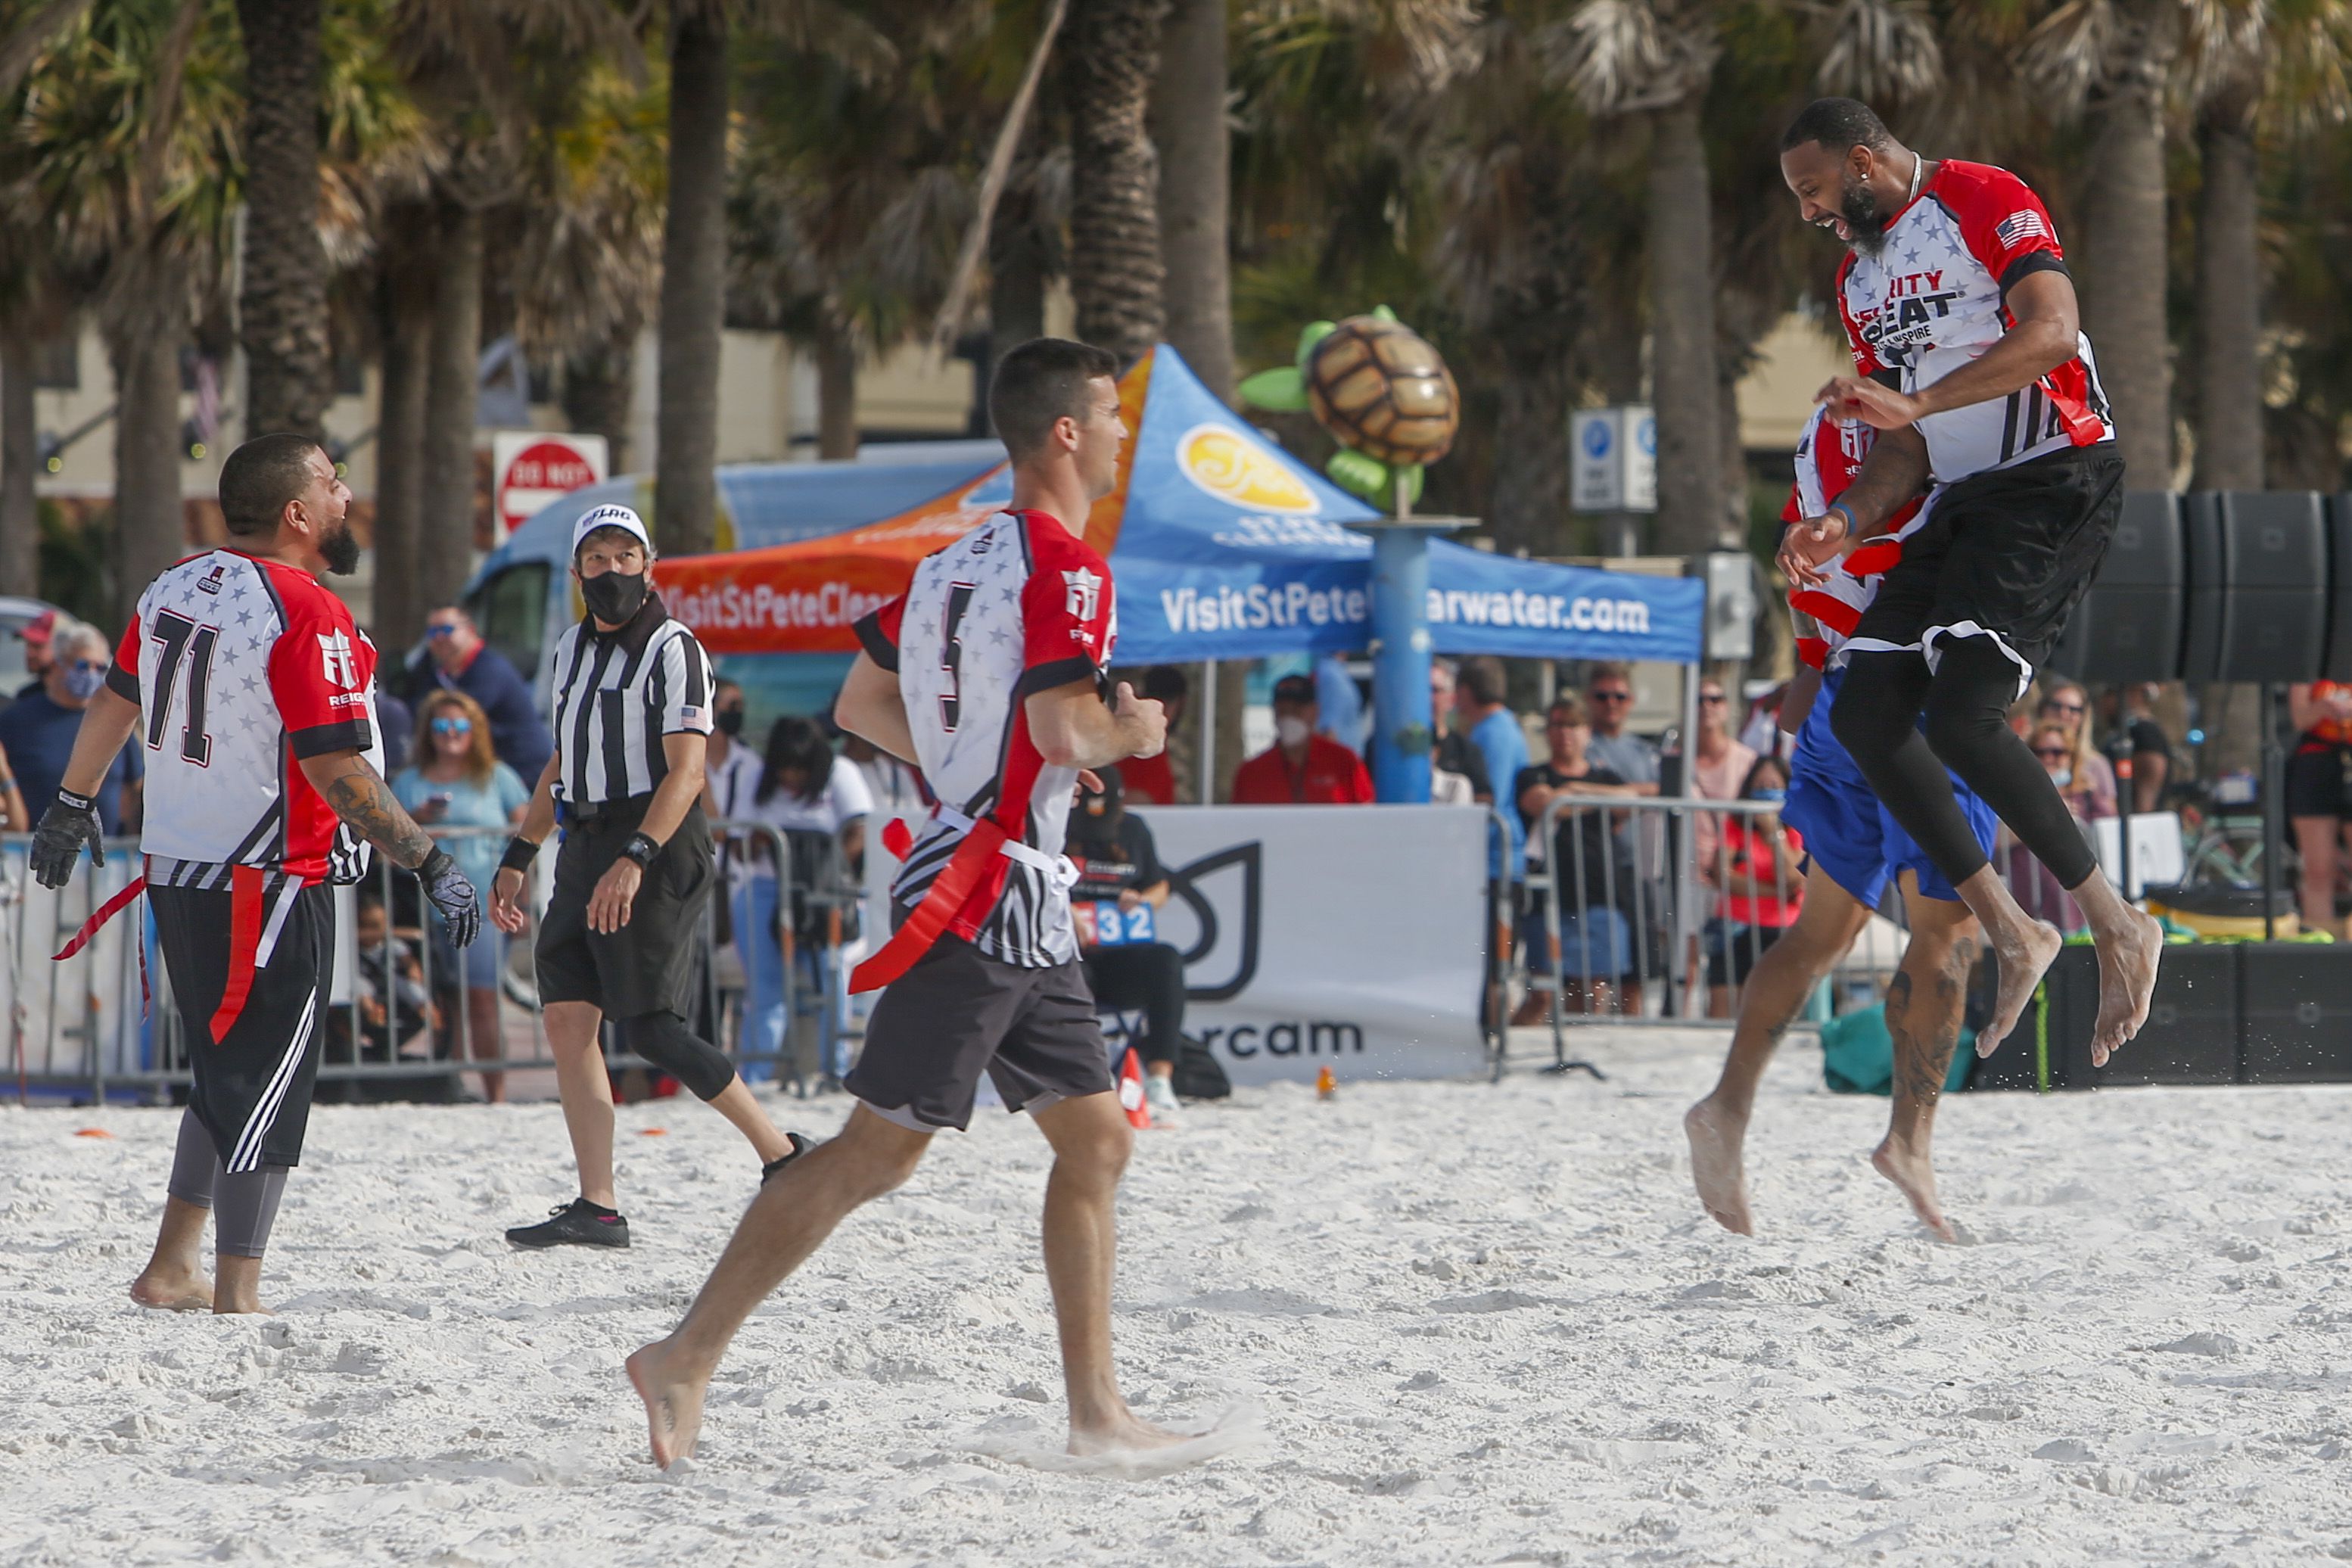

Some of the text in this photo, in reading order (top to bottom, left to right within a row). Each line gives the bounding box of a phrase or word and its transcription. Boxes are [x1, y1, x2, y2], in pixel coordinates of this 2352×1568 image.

[592, 509, 630, 521] FLAG
[148, 608, 222, 768] 71
[328, 692, 366, 706] REIG
